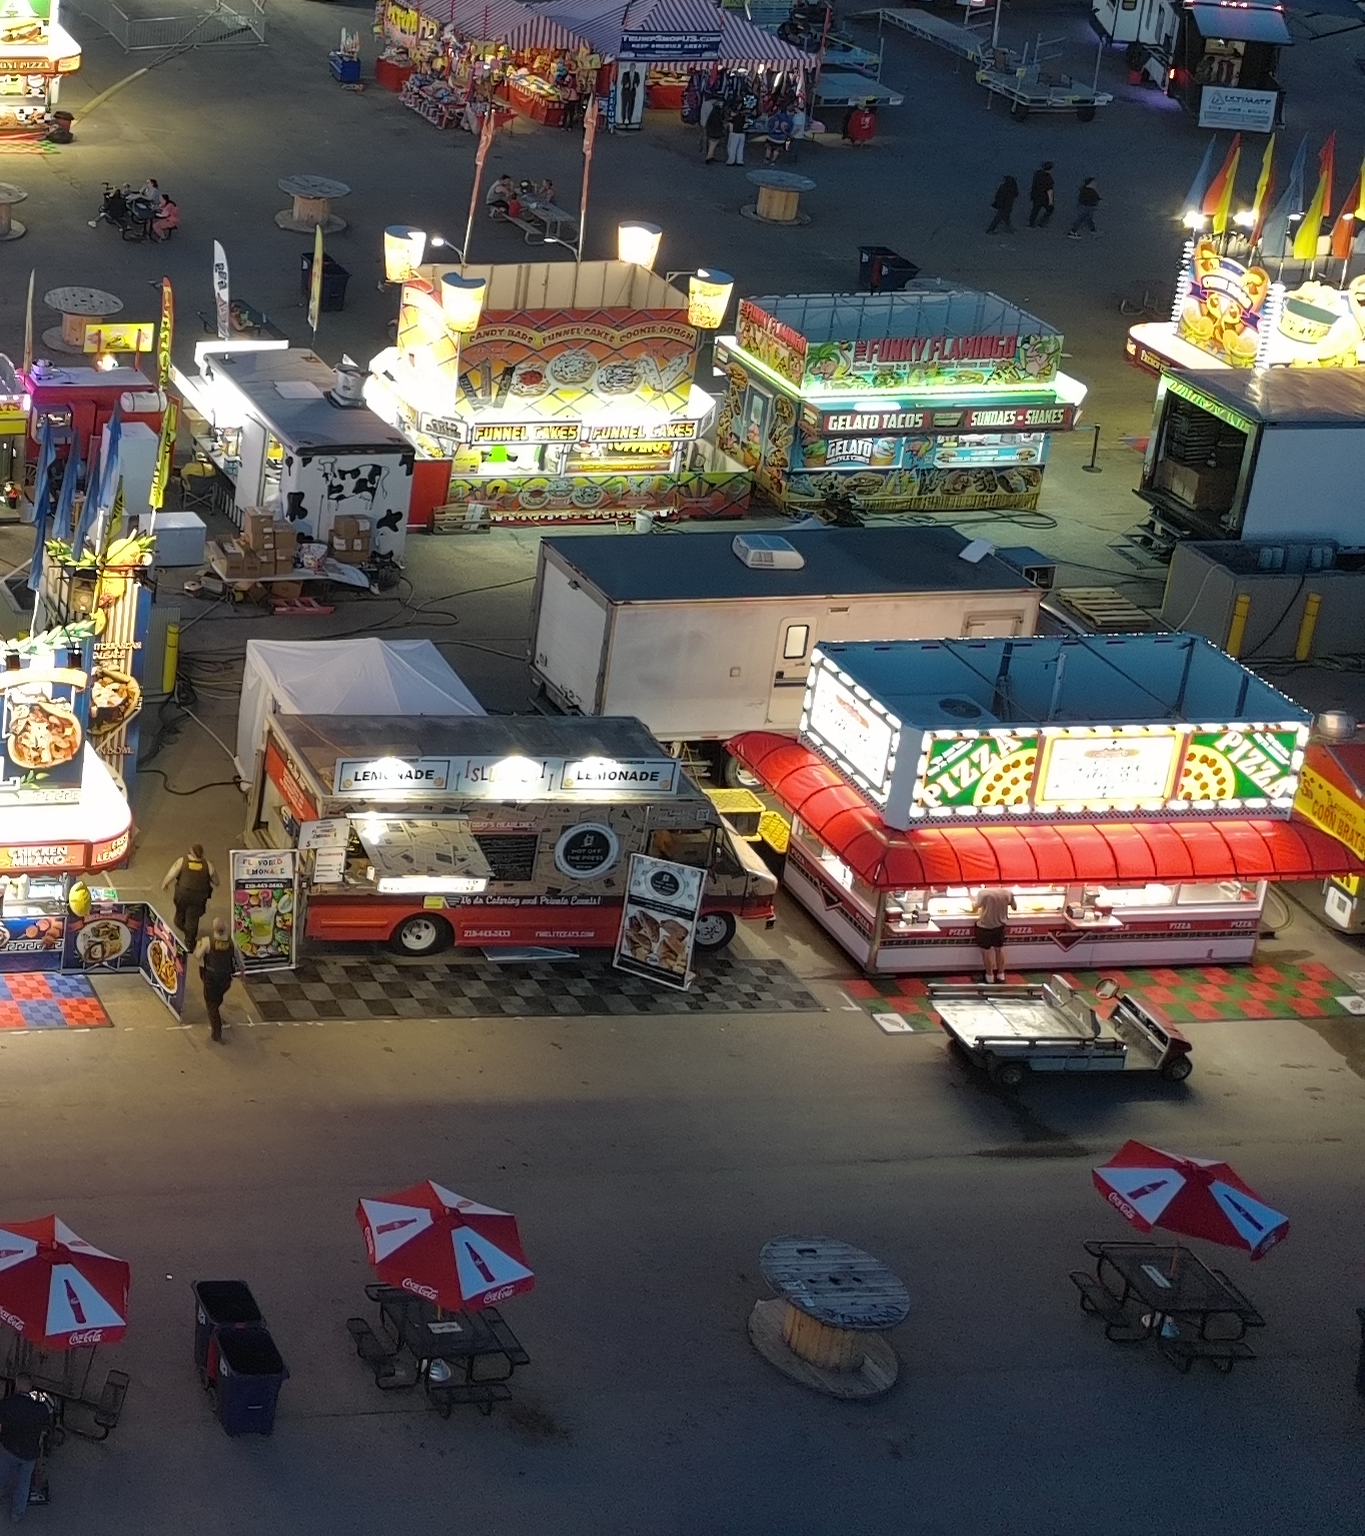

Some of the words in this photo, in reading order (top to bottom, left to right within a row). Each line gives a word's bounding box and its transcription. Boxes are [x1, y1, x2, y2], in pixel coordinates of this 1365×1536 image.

[20, 61, 50, 69] PIZZA
[469, 328, 504, 343] CANDY
[507, 328, 534, 343] BARS
[542, 328, 581, 344] FUNNEL
[583, 327, 615, 343] CAKES
[619, 326, 658, 343] COOKIE
[659, 325, 695, 341] DOUGH
[768, 316, 807, 354] FLAMINGO
[867, 336, 927, 362] FUNKY
[928, 334, 1019, 361] FLAMINGO
[828, 414, 880, 430] GELATO
[881, 413, 924, 428] TACOS
[970, 411, 1017, 426] SUNDAES
[1024, 409, 1064, 425] SHAKES
[475, 427, 529, 441] FUNNEL
[533, 425, 579, 441] CAKES
[591, 426, 646, 440] FUNNEL
[651, 423, 696, 439] CAKES
[827, 438, 872, 457] GELATO
[921, 733, 1024, 809] PIZZA
[1212, 729, 1293, 800] PIZZA
[354, 768, 435, 782] LEMNADE
[1311, 799, 1337, 831] CORN
[8, 847, 68, 858] CHICKEN
[521, 895, 538, 905] and
[948, 928, 971, 936] PIZZA
[1009, 926, 1034, 934] PIZZA
[1230, 920, 1253, 928] PIZZA
